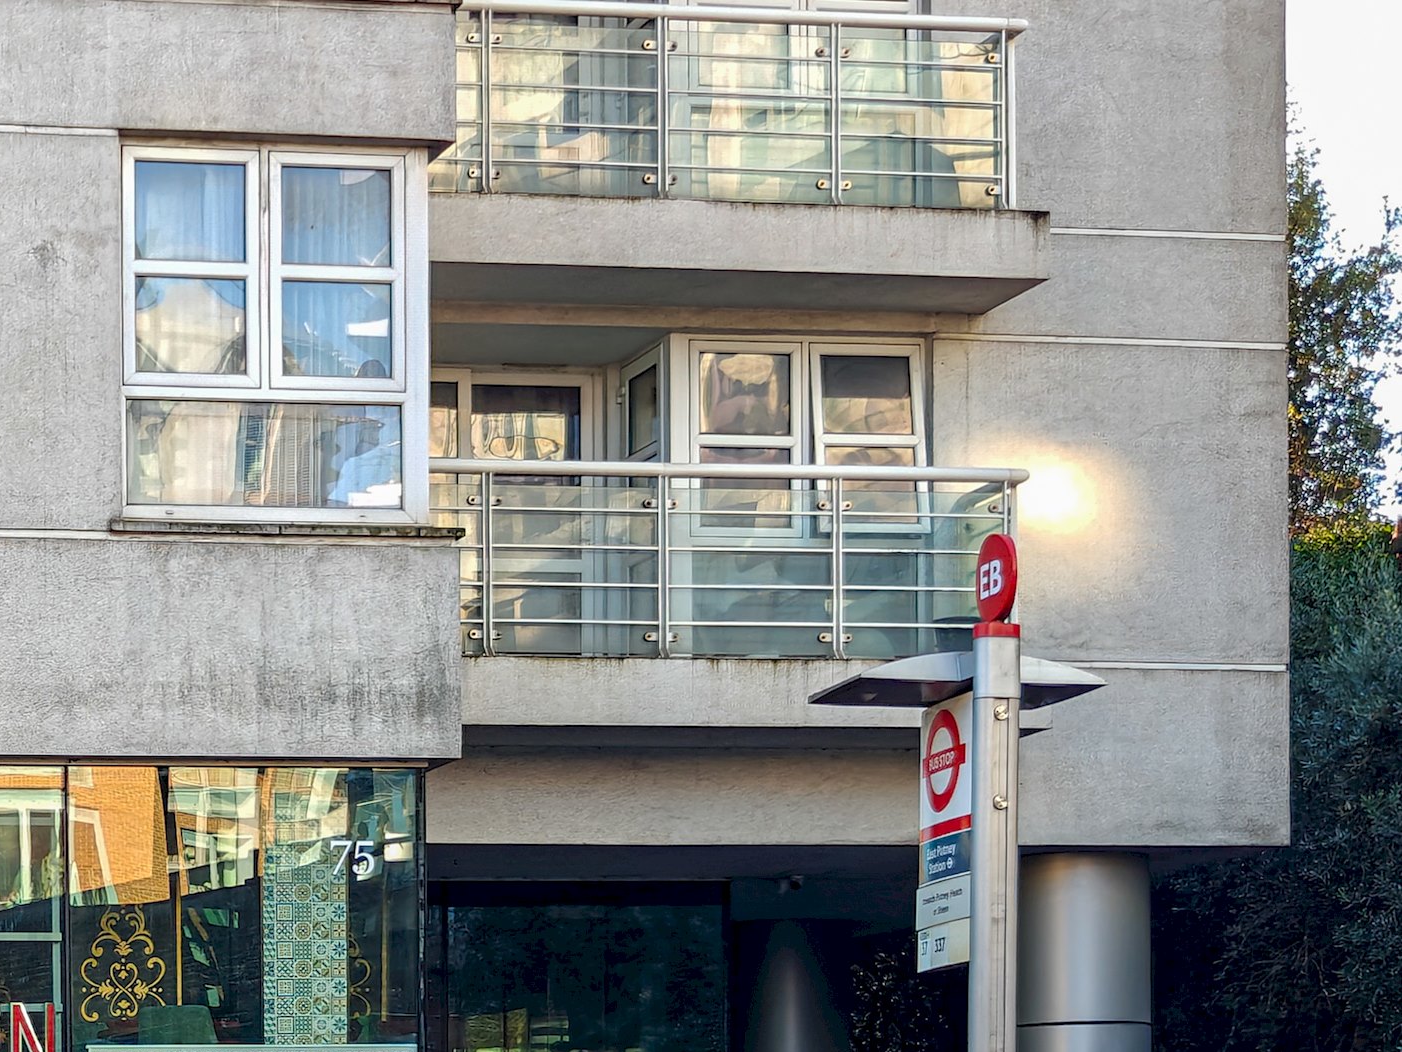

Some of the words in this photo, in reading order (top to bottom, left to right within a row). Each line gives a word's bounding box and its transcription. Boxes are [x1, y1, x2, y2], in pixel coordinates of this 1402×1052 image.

[980, 560, 1002, 600] EB
[929, 756, 938, 771] BUS
[938, 750, 956, 767] STOP
[329, 840, 375, 876] 75
[926, 845, 936, 860] East
[936, 842, 957, 859] Putney
[928, 860, 946, 875] Station
[934, 936, 947, 953] 337
